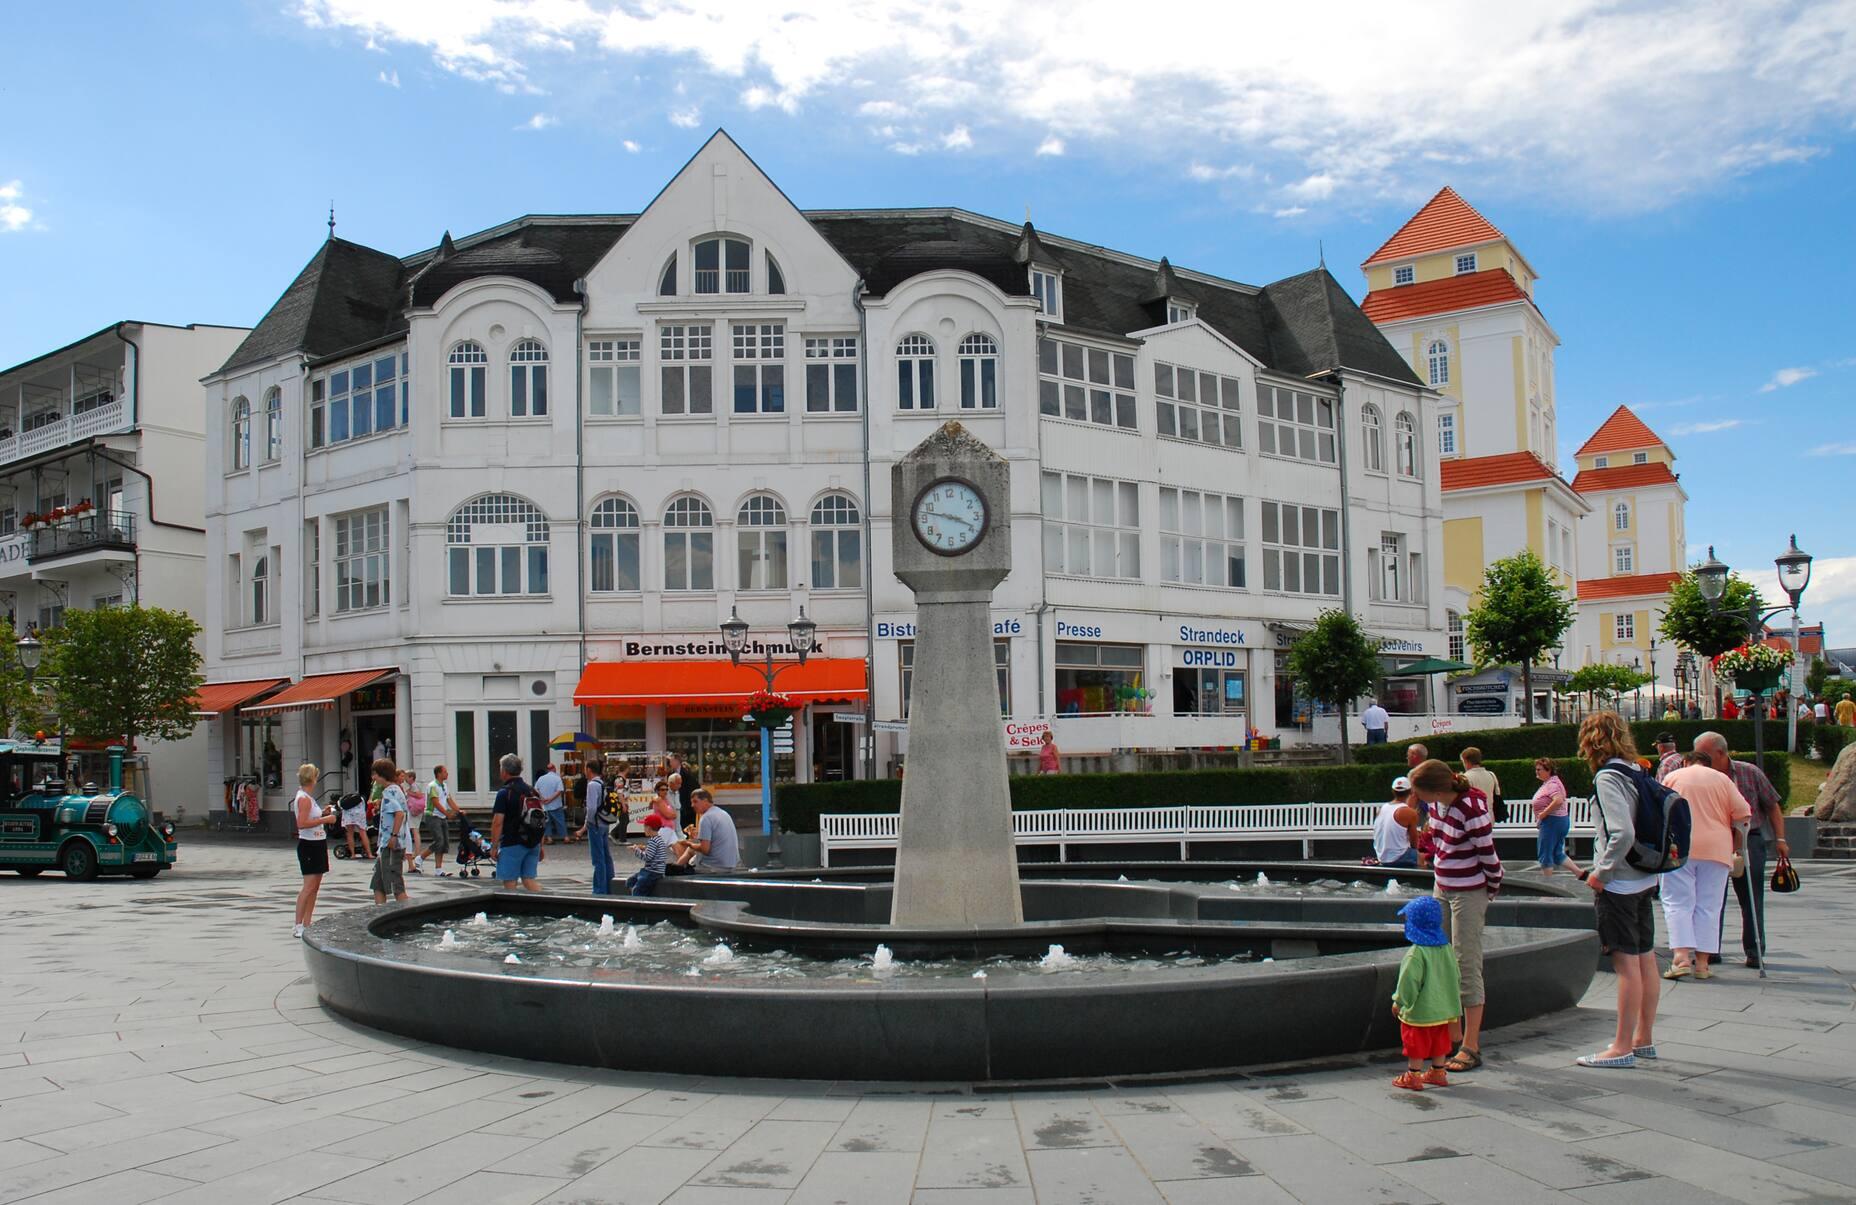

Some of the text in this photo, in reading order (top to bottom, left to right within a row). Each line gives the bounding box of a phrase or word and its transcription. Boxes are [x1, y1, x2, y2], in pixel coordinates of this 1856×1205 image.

[877, 618, 1020, 637] Bistr afé
[1057, 622, 1101, 637] Presse
[1180, 625, 1245, 645] Strandeck
[626, 640, 823, 656] Bernsteinchmuk
[1184, 650, 1235, 666] ORPLID
[1006, 723, 1049, 735] Crêpes
[1009, 736, 1045, 747] & Sek
